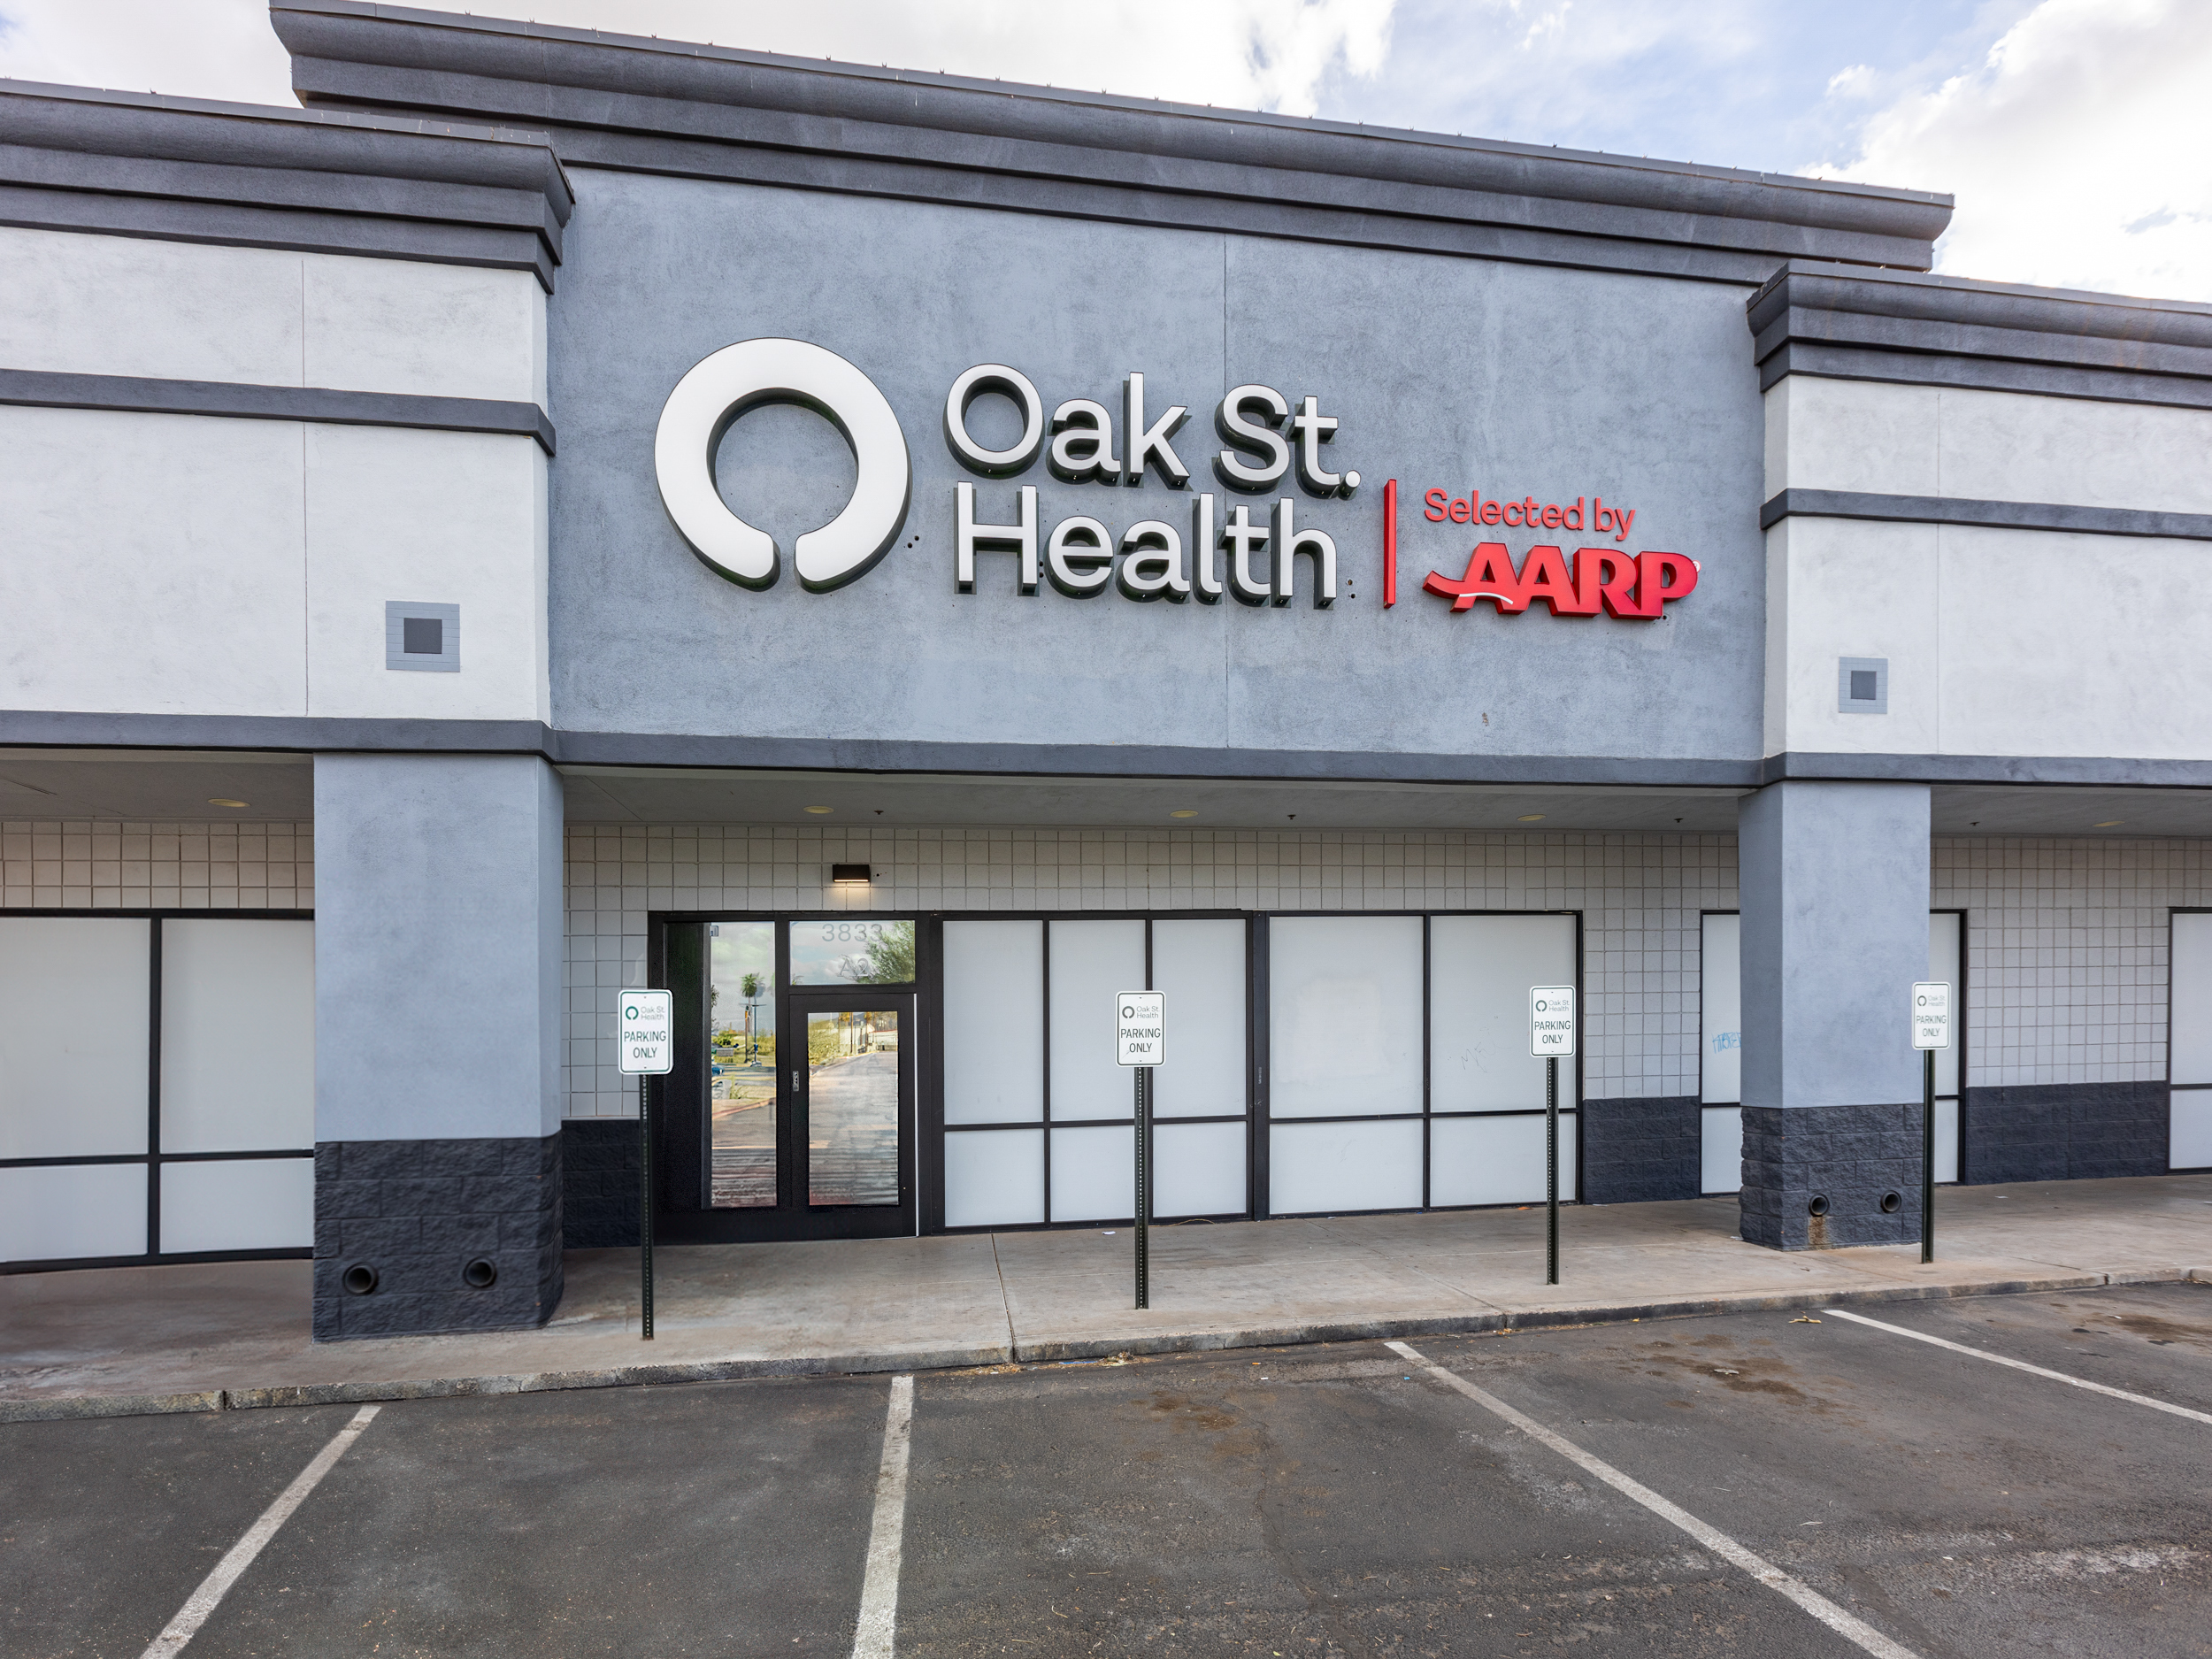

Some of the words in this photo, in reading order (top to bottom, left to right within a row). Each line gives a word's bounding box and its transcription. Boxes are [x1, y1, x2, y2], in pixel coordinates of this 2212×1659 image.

[944, 363, 1191, 489] Oak
[1214, 383, 1361, 496] St.
[1424, 488, 1585, 530] Selected
[1595, 497, 1636, 541] by
[955, 481, 1337, 608] Health
[1423, 542, 1698, 620] AARP
[821, 923, 883, 942] 3833
[1534, 1020, 1571, 1031] PARKING
[1916, 1015, 1947, 1024] PARKING
[624, 1030, 666, 1042] PARKING
[1120, 1027, 1161, 1039] PARKING
[1922, 1027, 1940, 1037] ONLY
[1542, 1033, 1563, 1044] ONLY
[633, 1047, 657, 1059] ONLY
[1129, 1042, 1152, 1053] ONLY
